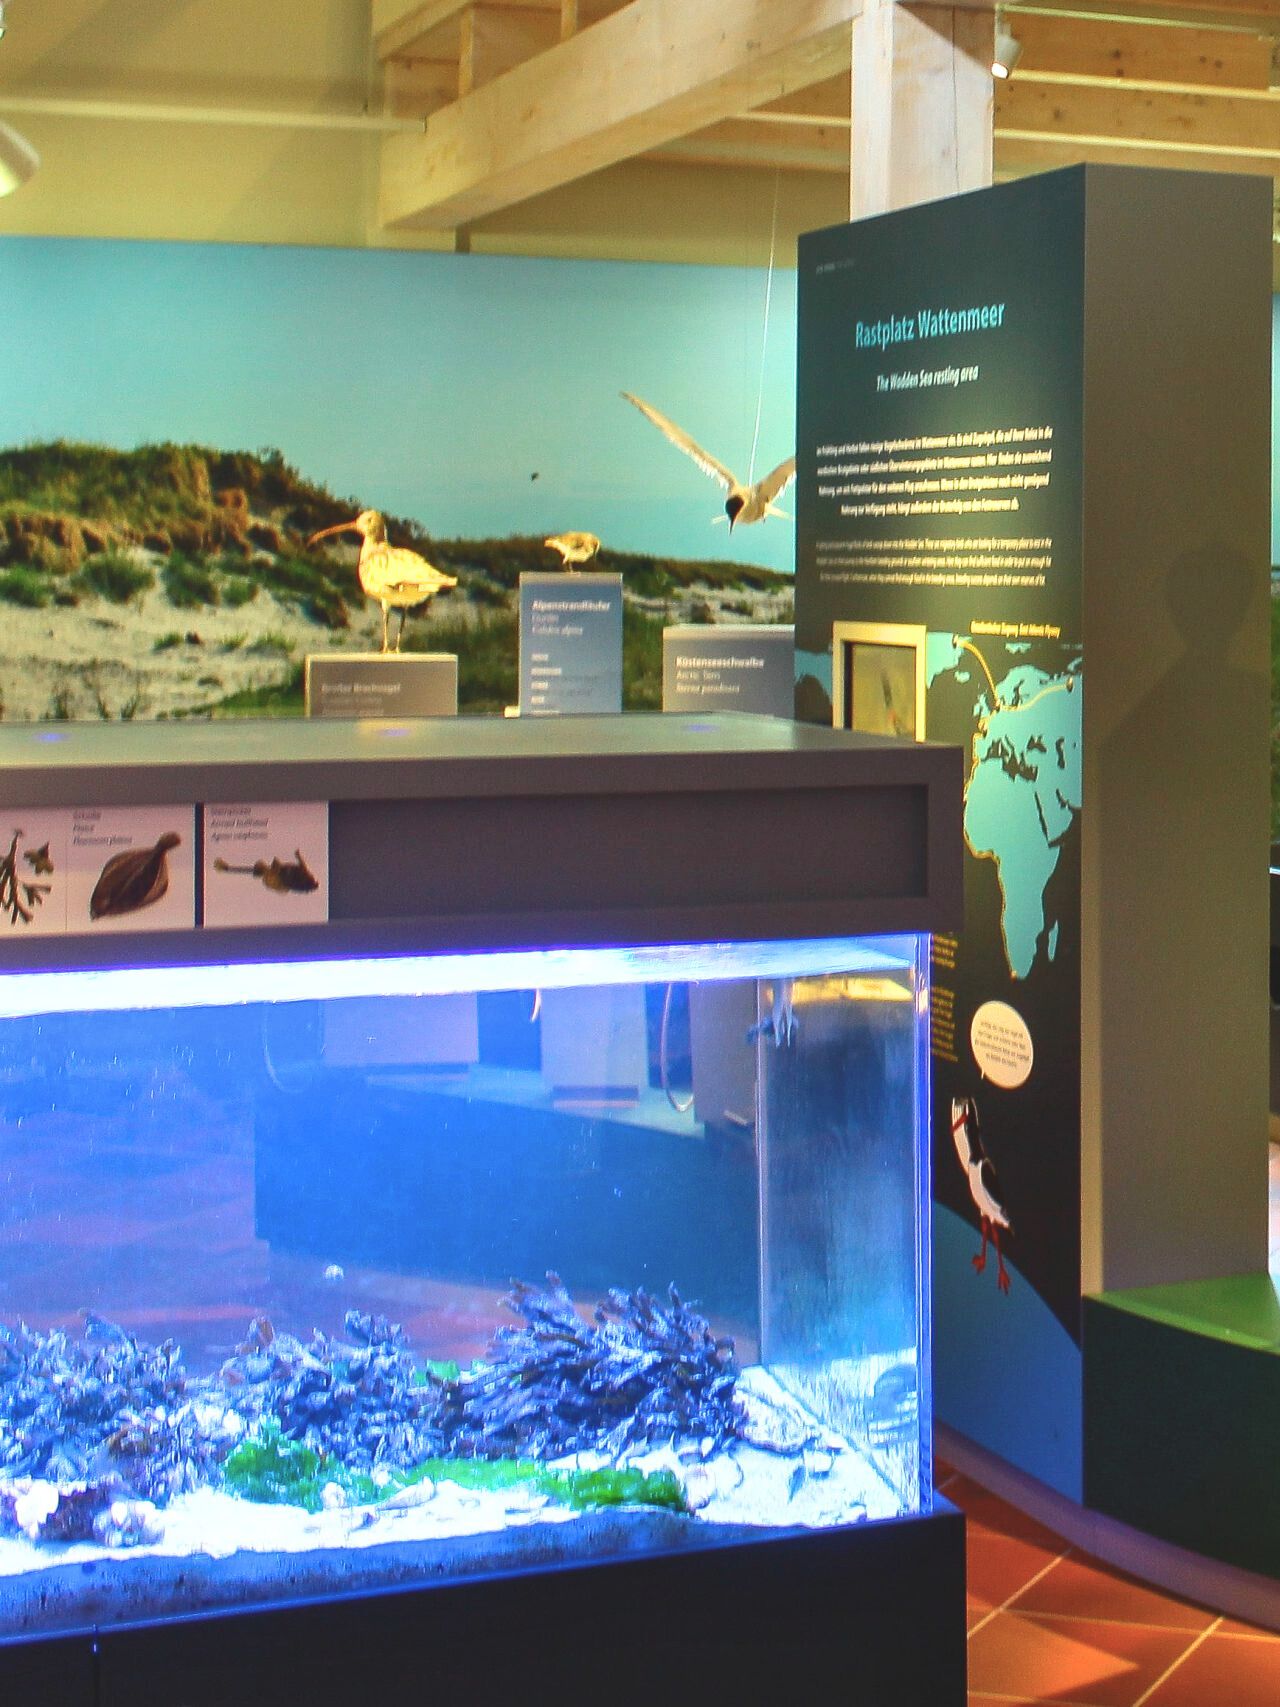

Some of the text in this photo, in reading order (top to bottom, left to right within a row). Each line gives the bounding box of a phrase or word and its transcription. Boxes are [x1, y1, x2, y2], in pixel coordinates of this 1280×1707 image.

[855, 303, 1005, 350] Rastplatz Wattenmeer
[876, 365, 979, 392] The Wadden Sea resting area
